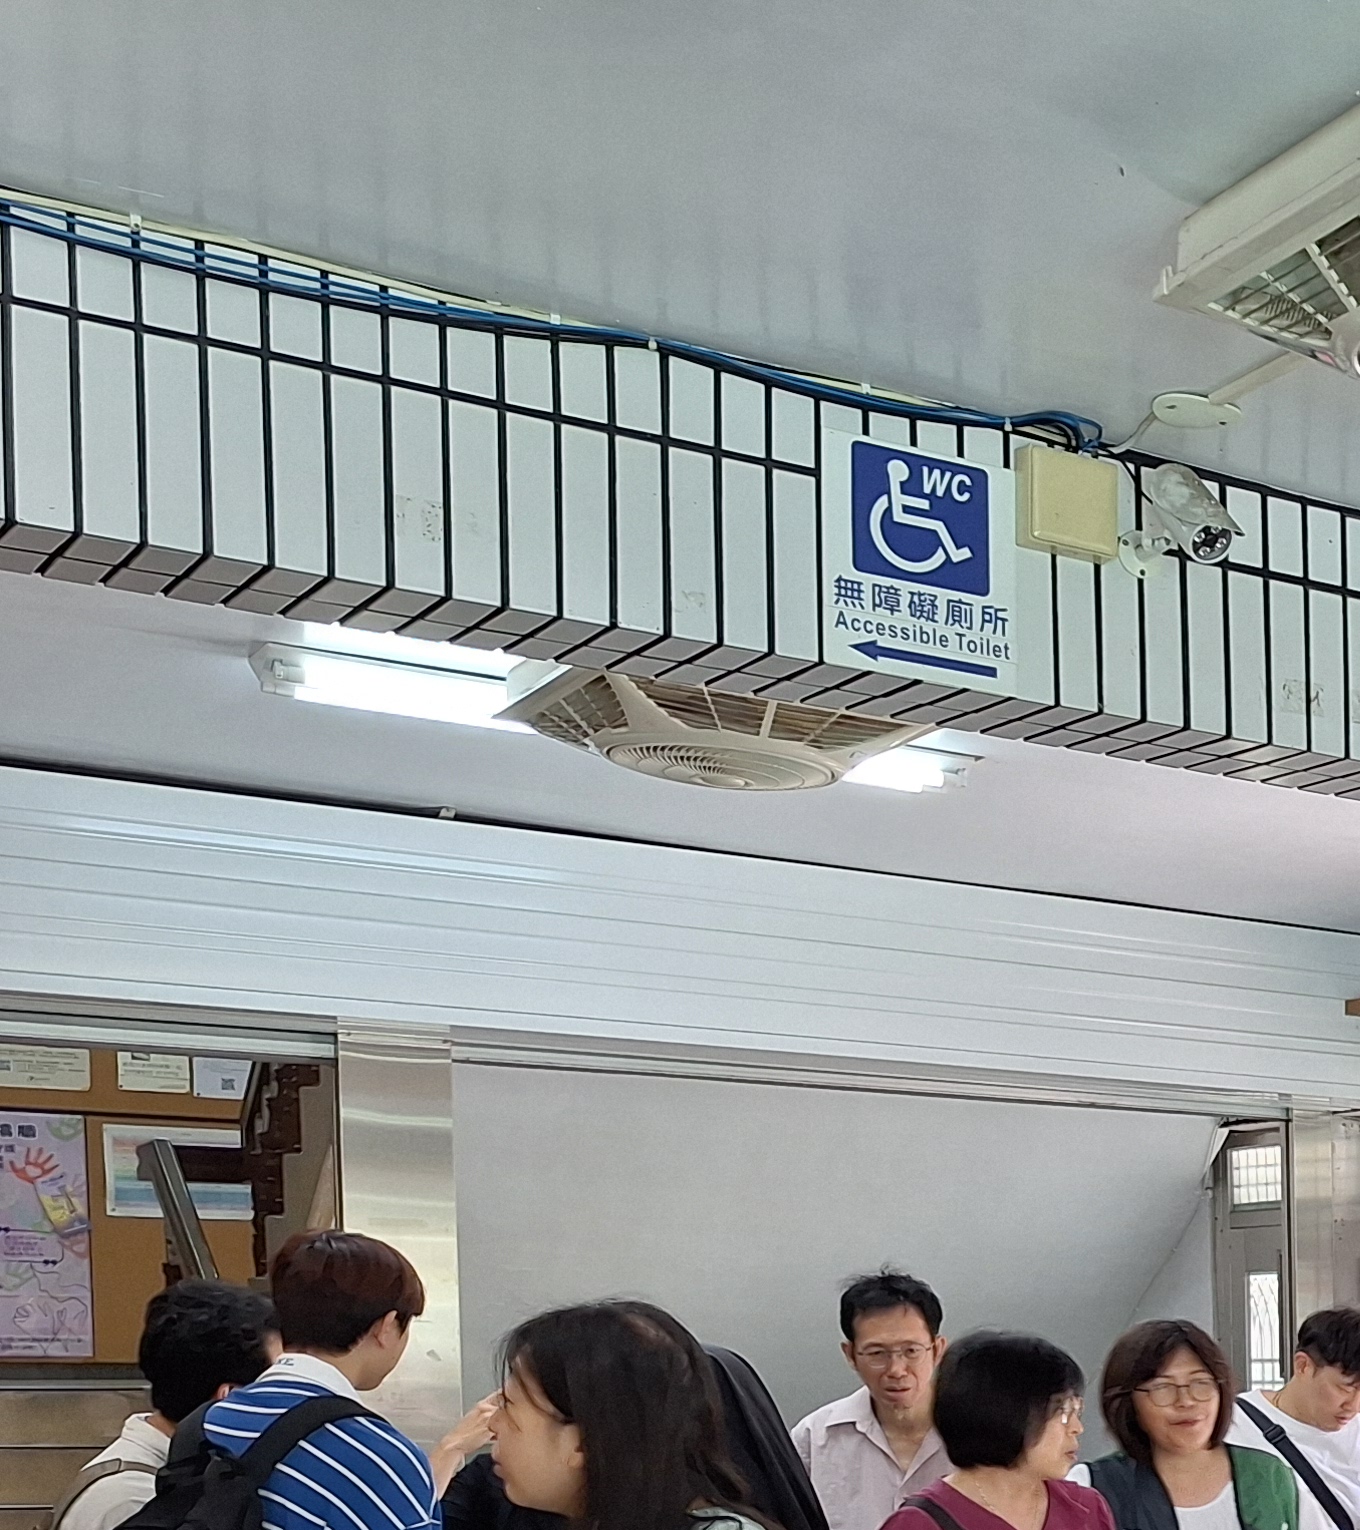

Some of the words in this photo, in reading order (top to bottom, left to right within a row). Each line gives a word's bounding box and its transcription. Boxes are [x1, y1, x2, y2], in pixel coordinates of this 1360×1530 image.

[921, 465, 973, 502] WC
[834, 574, 1009, 638] 無障礙廁所
[835, 609, 949, 649] Accessible
[954, 632, 1011, 660] Toilet
